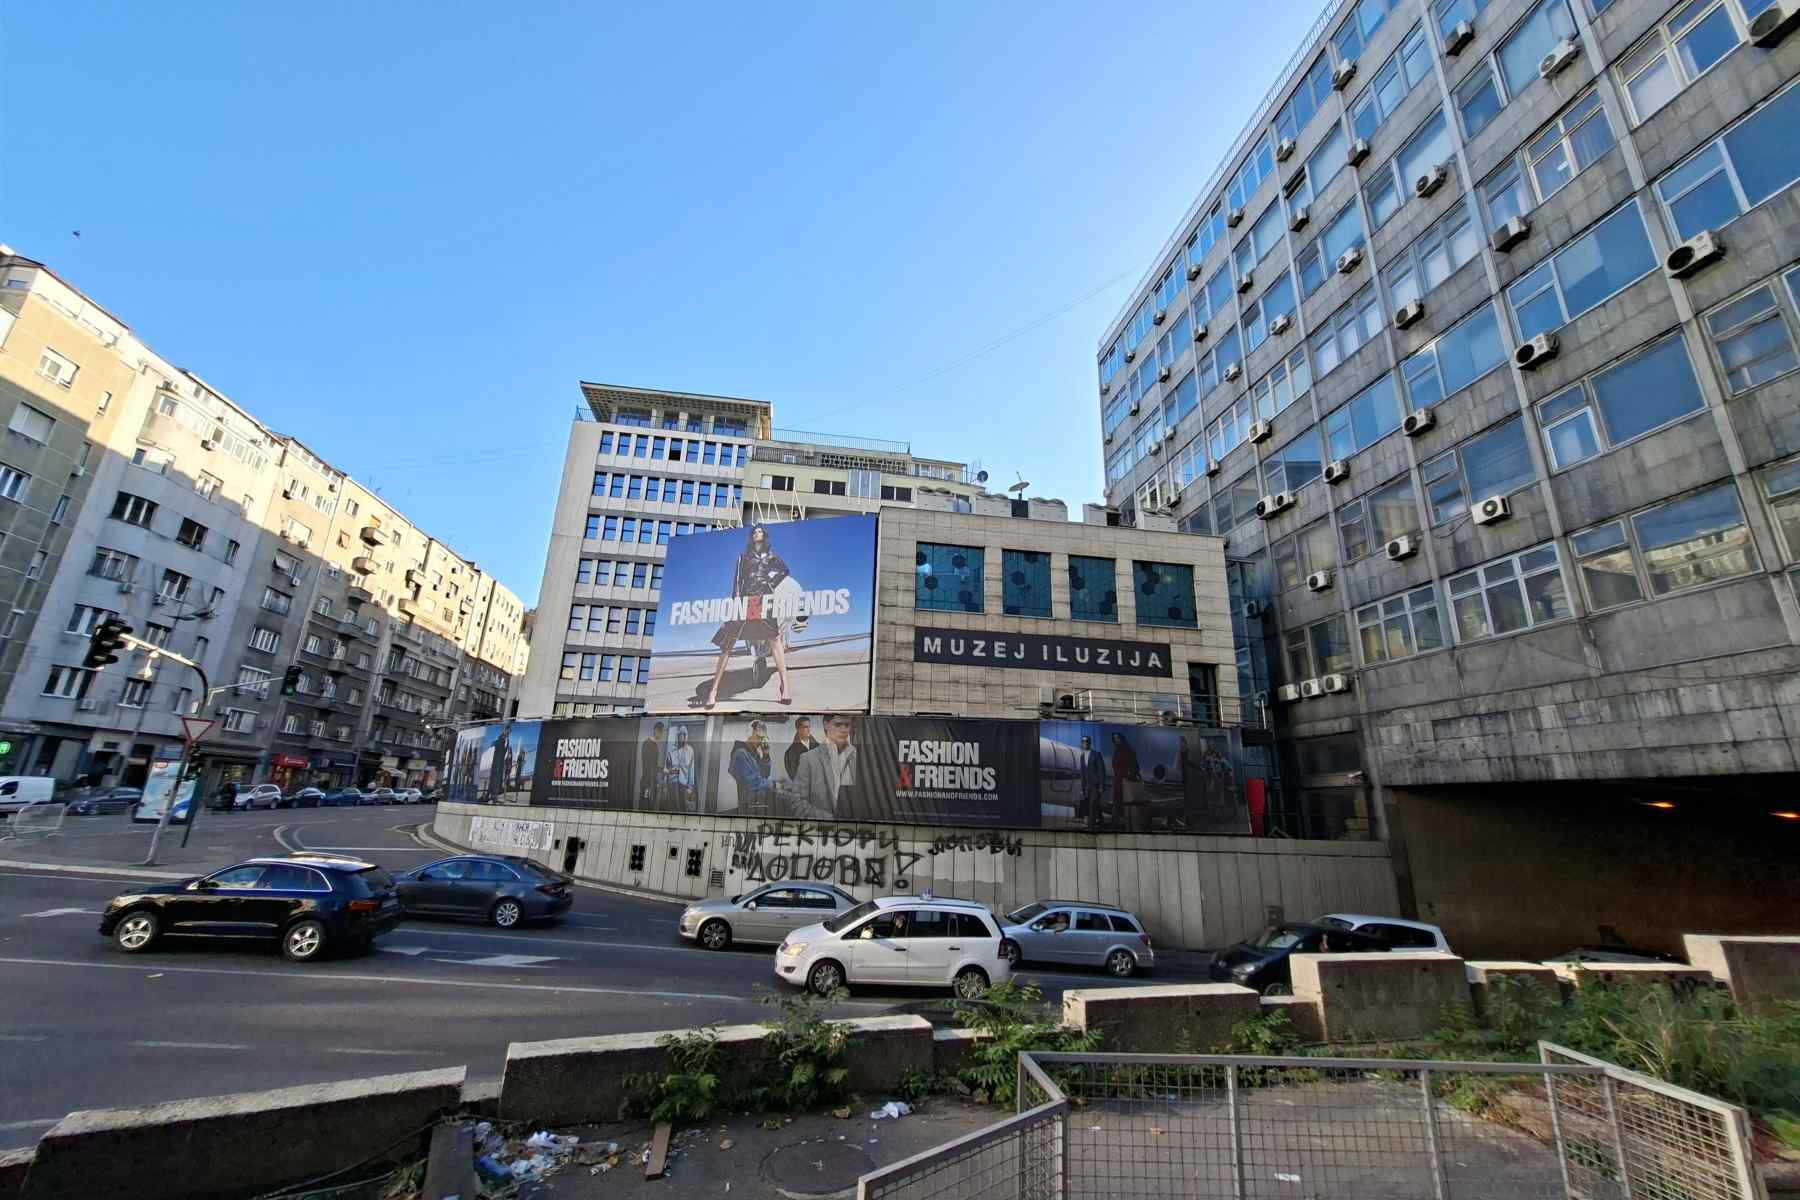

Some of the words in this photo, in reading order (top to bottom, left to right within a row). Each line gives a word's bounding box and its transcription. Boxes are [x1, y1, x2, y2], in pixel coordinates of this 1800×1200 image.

[923, 636, 1026, 660] MUZEJ
[1042, 644, 1164, 669] ILUZIJA
[556, 738, 601, 758] FASHION
[898, 740, 980, 764] FASHION
[896, 790, 999, 801] WWW.FASHIONANDFRIENDS.COM
